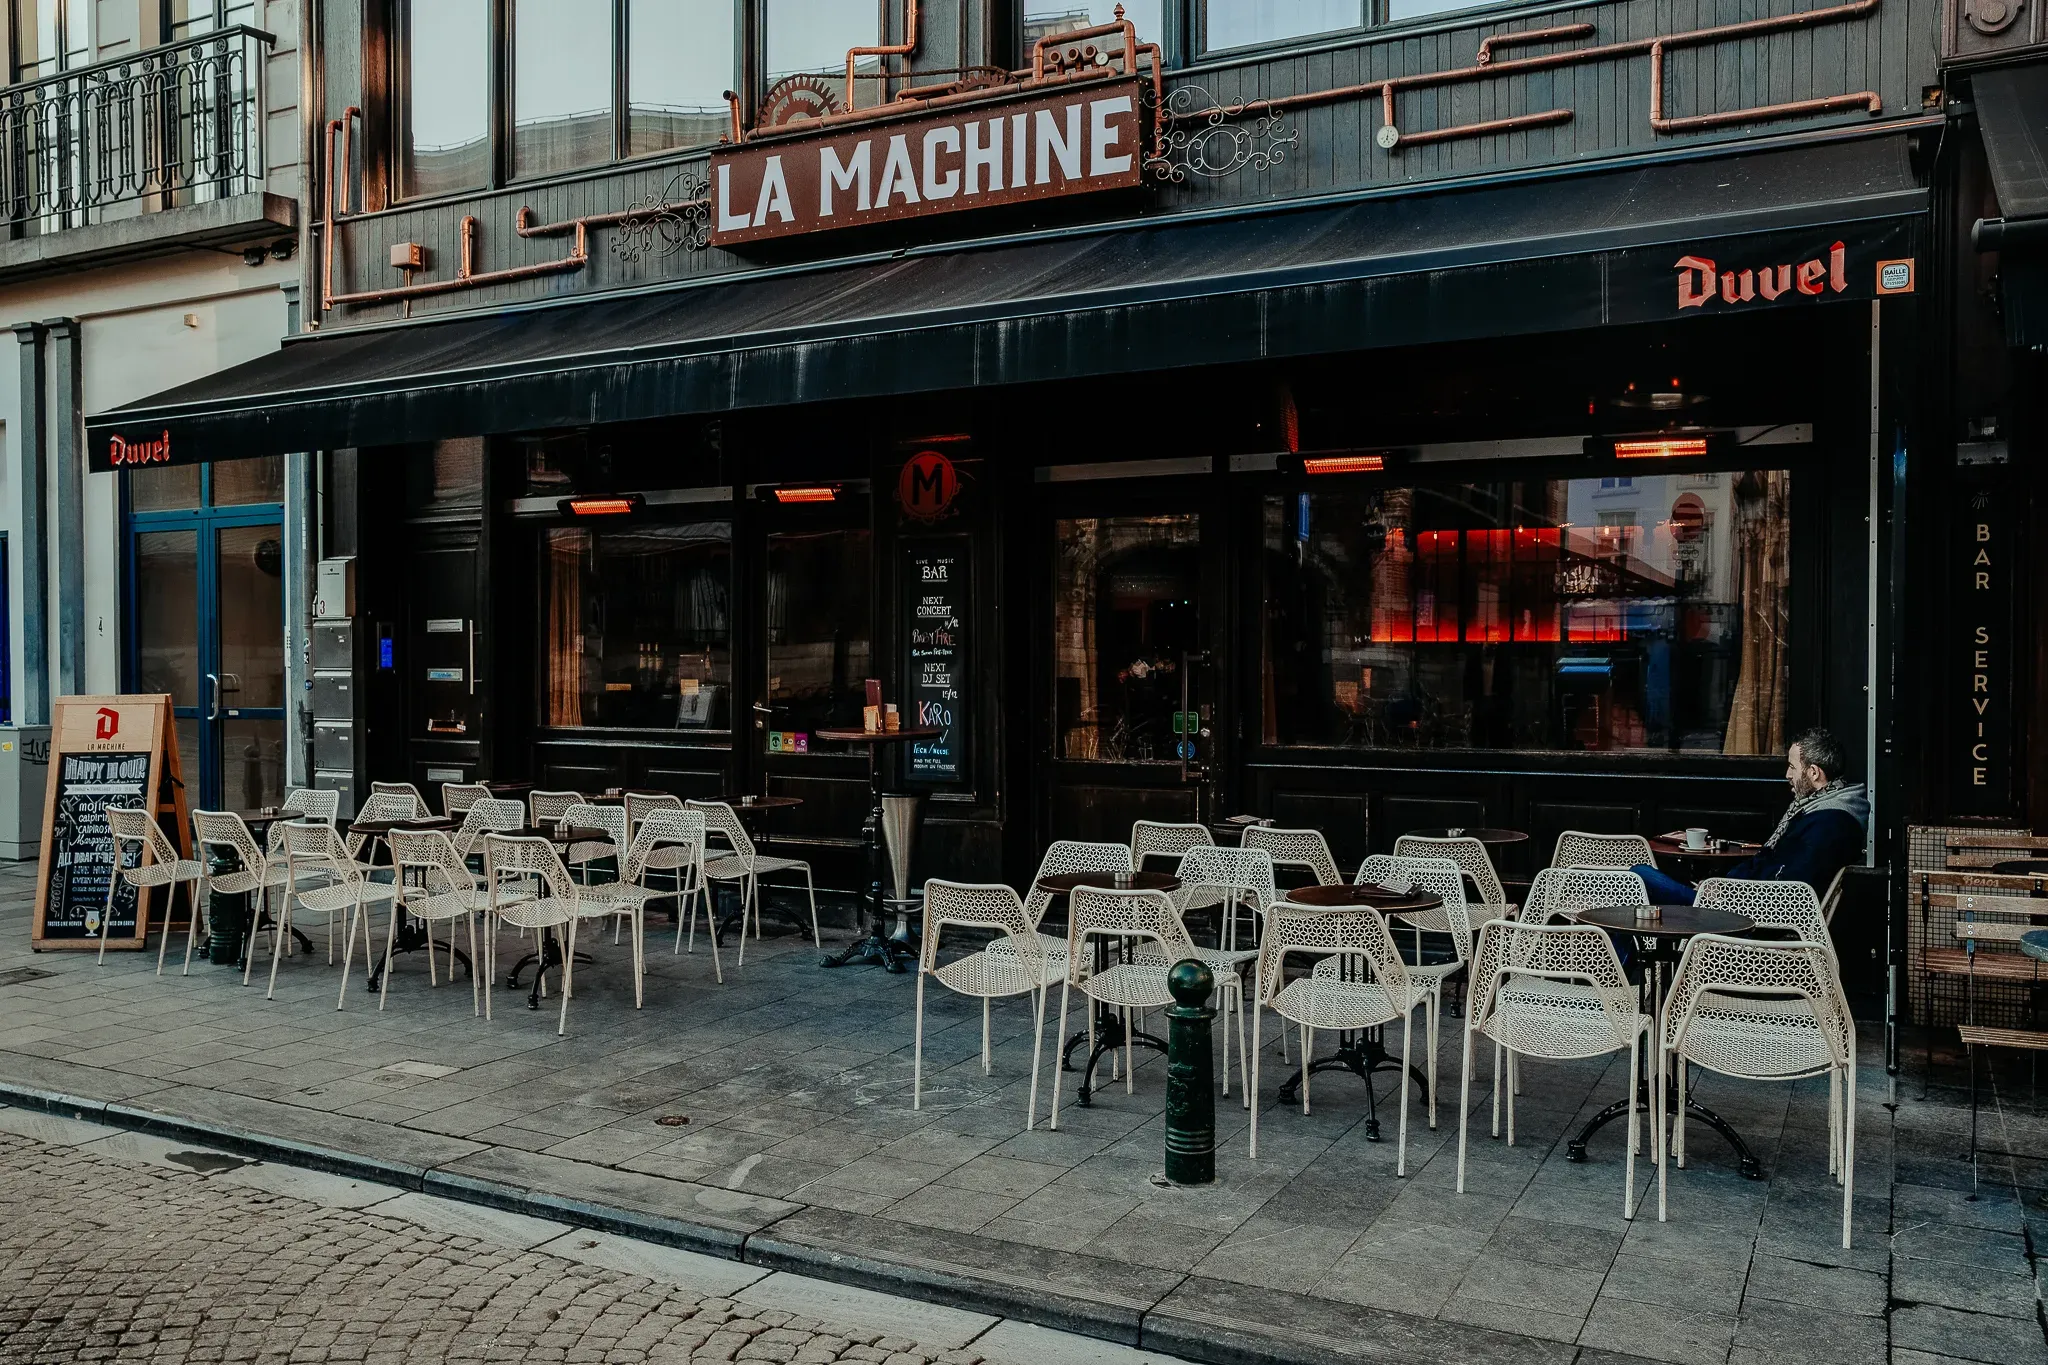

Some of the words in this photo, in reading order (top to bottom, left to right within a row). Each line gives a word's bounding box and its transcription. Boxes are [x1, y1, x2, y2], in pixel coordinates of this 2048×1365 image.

[717, 155, 796, 233] LA
[819, 95, 1133, 217] MACHINE
[1673, 240, 1848, 310] Duvel
[110, 429, 170, 466] Duvel
[912, 463, 943, 505] M
[1973, 523, 1991, 590] BAR
[922, 565, 948, 579] BAR
[916, 605, 952, 615] CONCERT
[922, 596, 944, 605] NEXT
[922, 673, 933, 684] DJ
[936, 673, 951, 684] SET
[924, 663, 946, 672] NEXT
[918, 700, 952, 726] KARO
[1972, 626, 1989, 785] SERVICE
[64, 756, 105, 780] HAPPY
[106, 757, 147, 779] HOUR
[57, 852, 72, 868] ALL
